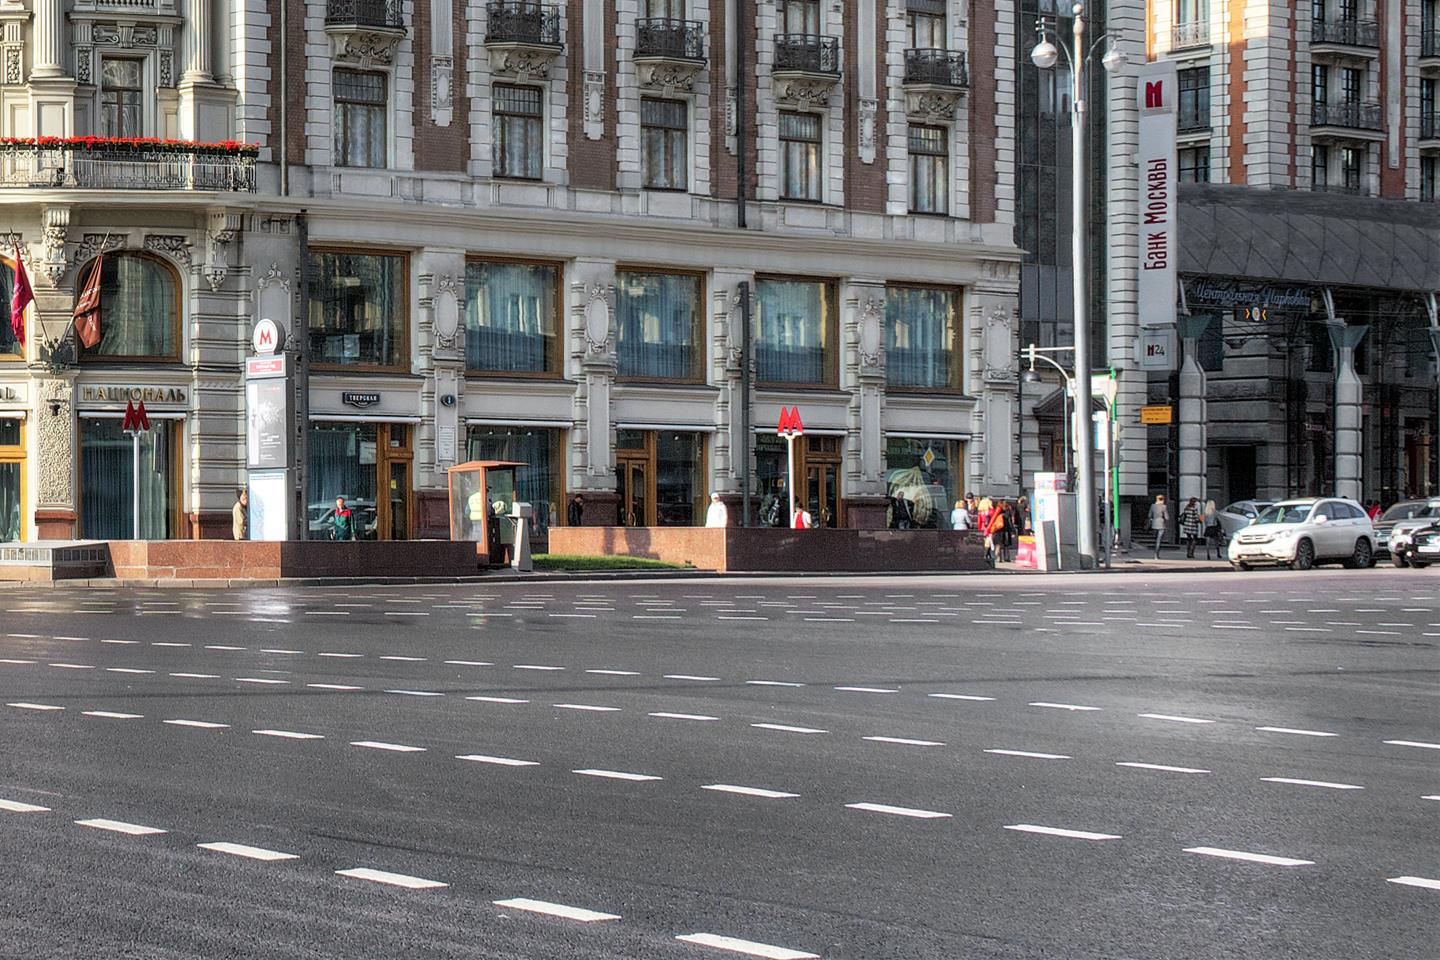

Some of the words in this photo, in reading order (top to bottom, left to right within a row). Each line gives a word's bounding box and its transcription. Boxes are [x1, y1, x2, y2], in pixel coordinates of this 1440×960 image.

[1144, 159, 1167, 224] Москвы
[1144, 232, 1167, 270] Банк
[260, 330, 272, 345] М
[83, 387, 186, 402] НАЦИОНАЛЬ
[122, 400, 150, 431] М
[777, 405, 804, 433] М
